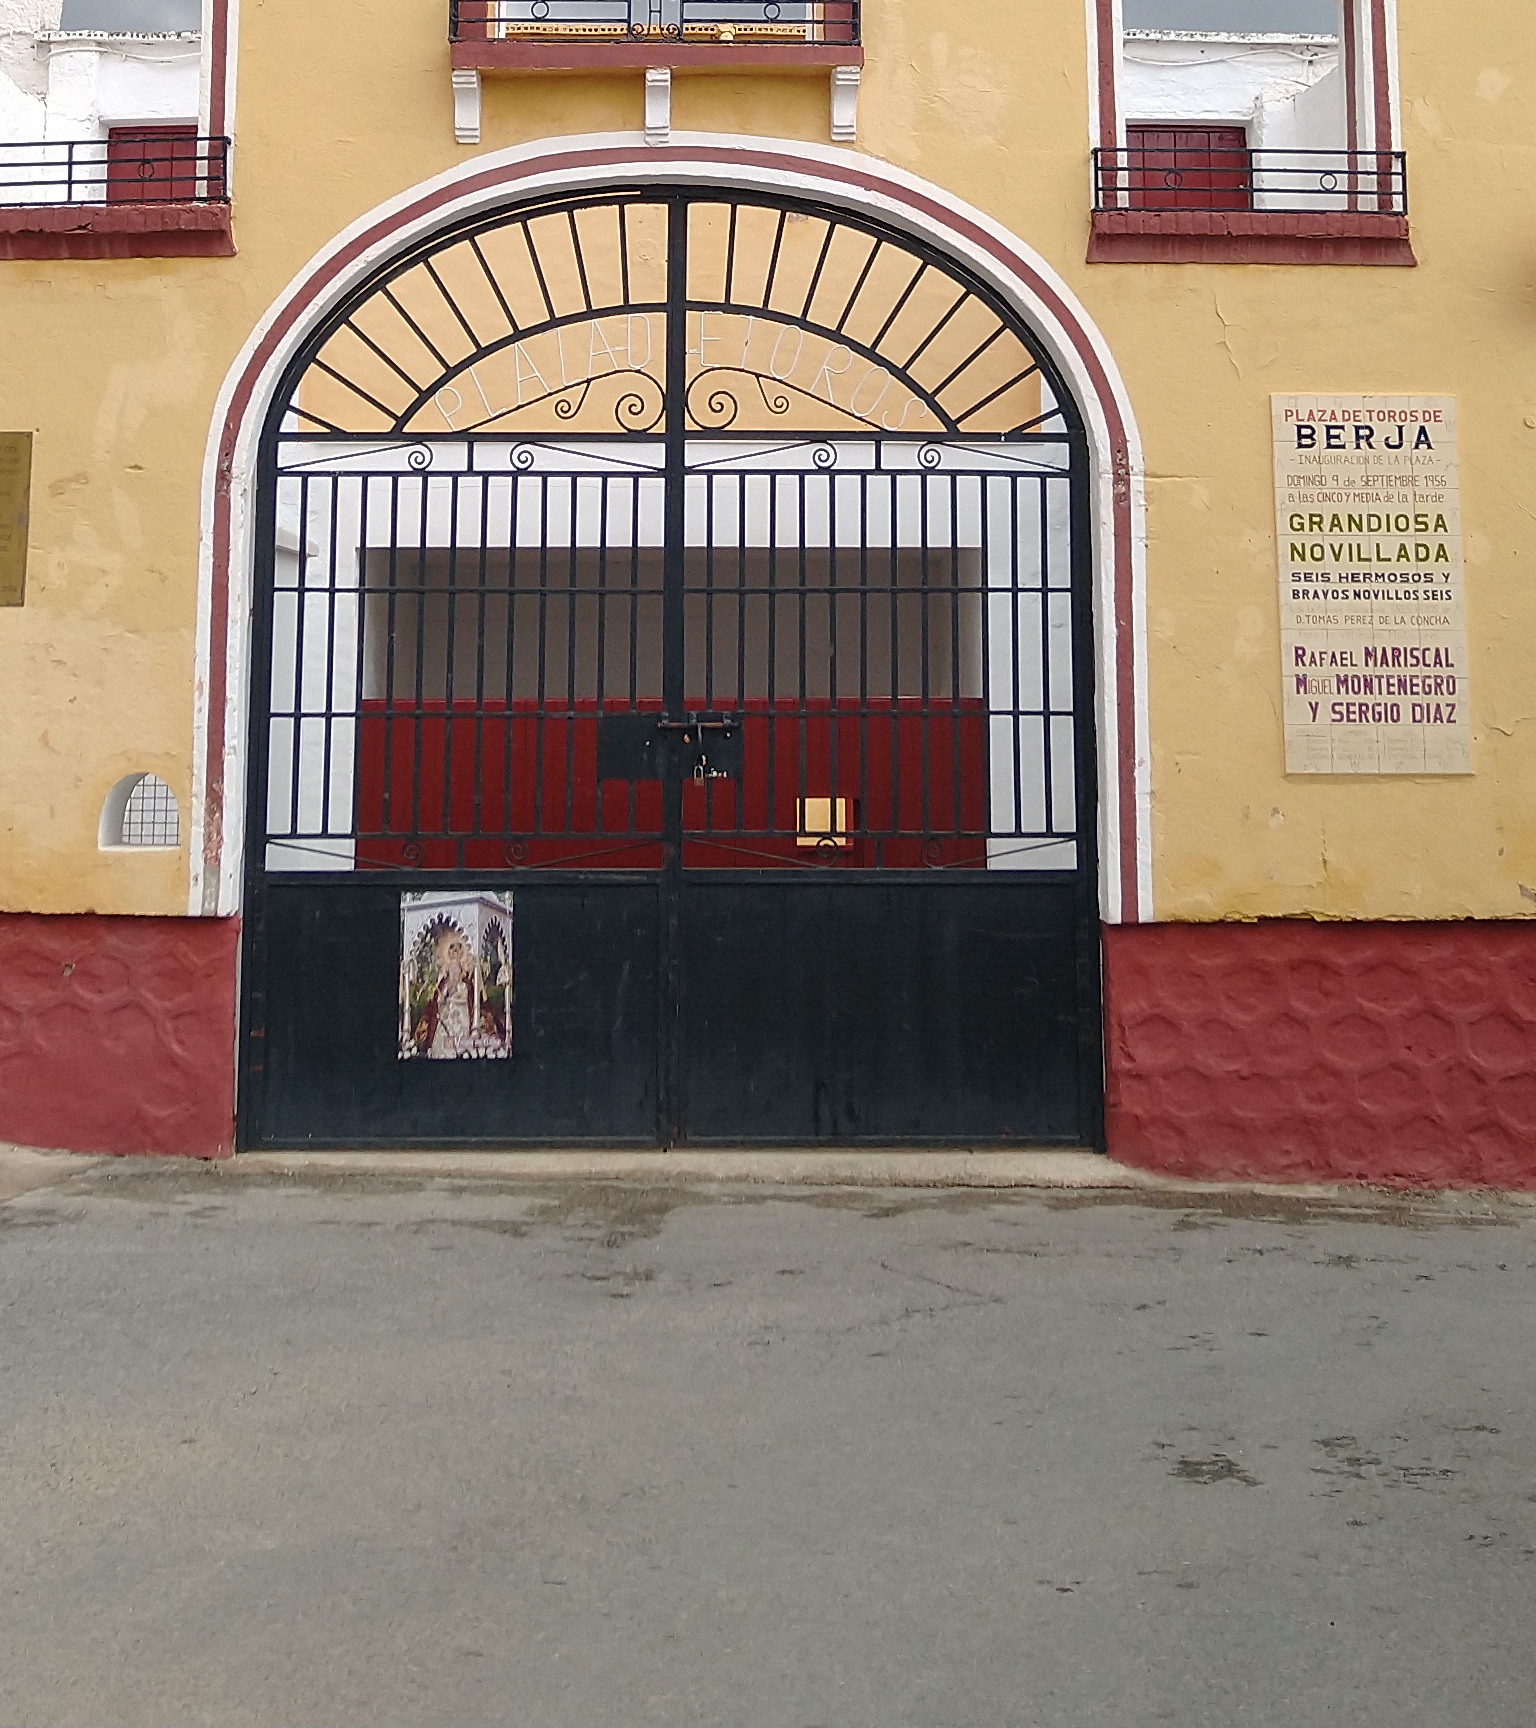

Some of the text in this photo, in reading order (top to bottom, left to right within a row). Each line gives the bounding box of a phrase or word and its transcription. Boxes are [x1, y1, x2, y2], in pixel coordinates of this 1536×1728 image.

[740, 314, 928, 431] TOROS
[1284, 408, 1443, 423] PLAZA DE TOROS DE
[1294, 424, 1435, 450] BERJA
[1297, 454, 1434, 465] INAUGURACION DE LA PLAZA
[1286, 474, 1447, 487] DOMINGO 9 de SEPTIEMBRE 1956
[1288, 491, 1445, 503] a las CINCO Y MEDIA de la tarde
[1289, 513, 1448, 533] GRANDIOSA
[1290, 542, 1450, 563] NOVILLADA
[1291, 572, 1451, 583] SEIS HERMOSOS Y
[1292, 589, 1452, 601] BRAVOS NOVILLOS SEIS
[1344, 615, 1374, 625] PEREZ
[1379, 615, 1390, 625] DE
[1394, 616, 1406, 625] LA
[1410, 616, 1450, 626] CONCHA
[1364, 646, 1455, 668] MARISCAL
[1336, 674, 1456, 696] MONTENEGRO
[1307, 701, 1457, 724] Y SERGIO DIAZ
